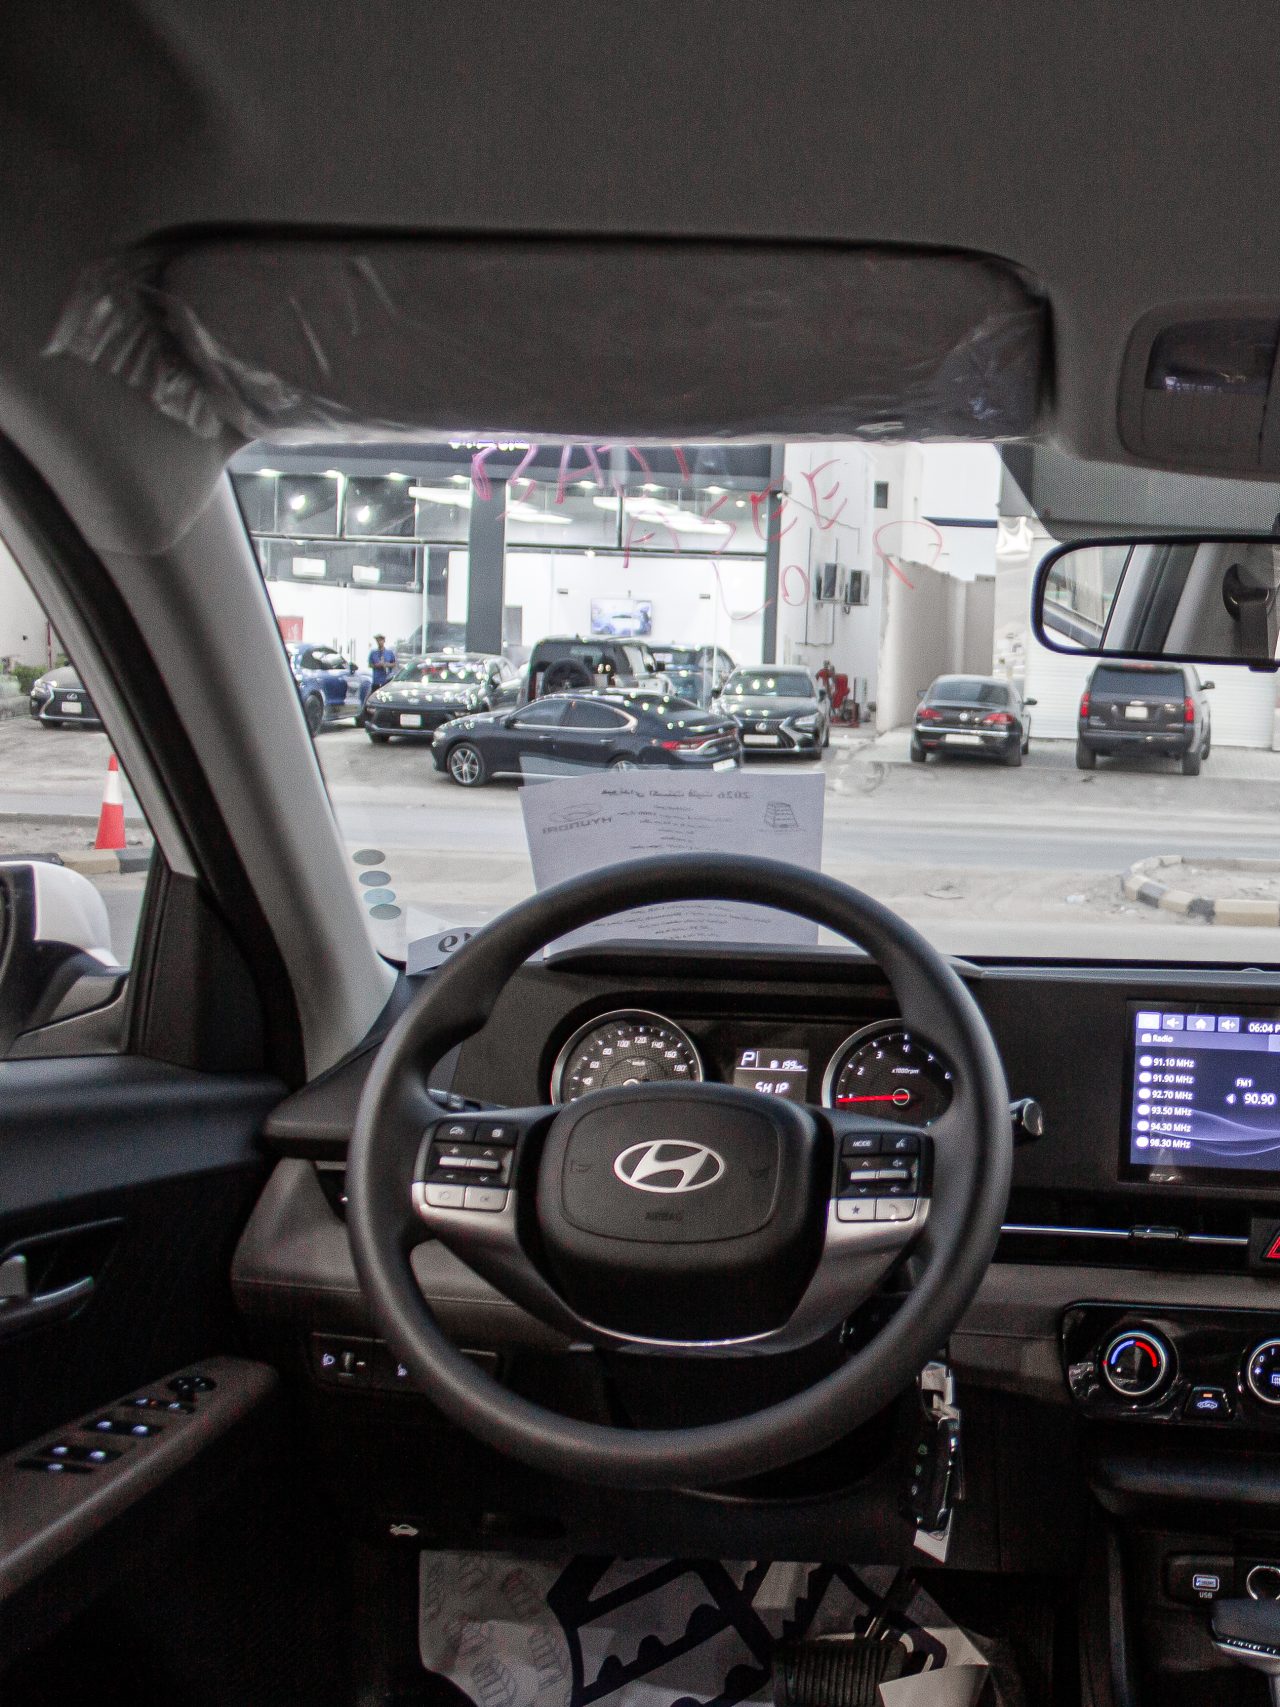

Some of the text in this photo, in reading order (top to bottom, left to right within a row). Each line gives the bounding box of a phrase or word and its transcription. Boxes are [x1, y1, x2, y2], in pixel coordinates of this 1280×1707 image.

[1249, 1023, 1273, 1033] 06:04
[634, 1036, 647, 1044] 120
[1152, 1034, 1174, 1043] Radio
[617, 1040, 630, 1048] 100
[651, 1041, 664, 1049] 140
[902, 1044, 911, 1053] 4
[741, 1051, 755, 1066] P
[875, 1050, 883, 1060] 3
[1153, 1058, 1195, 1068] 91.10 MHz
[857, 1066, 864, 1076] 2
[1152, 1074, 1194, 1084] 91.90 MHz
[1236, 1078, 1252, 1088] FM1
[1151, 1090, 1193, 1100] 92.70 MHz
[1244, 1093, 1275, 1105] 90.90
[1151, 1106, 1192, 1116] 93.50 MHz
[1150, 1122, 1191, 1132] 94.30 MHz
[1172, 1139, 1191, 1149] MHz
